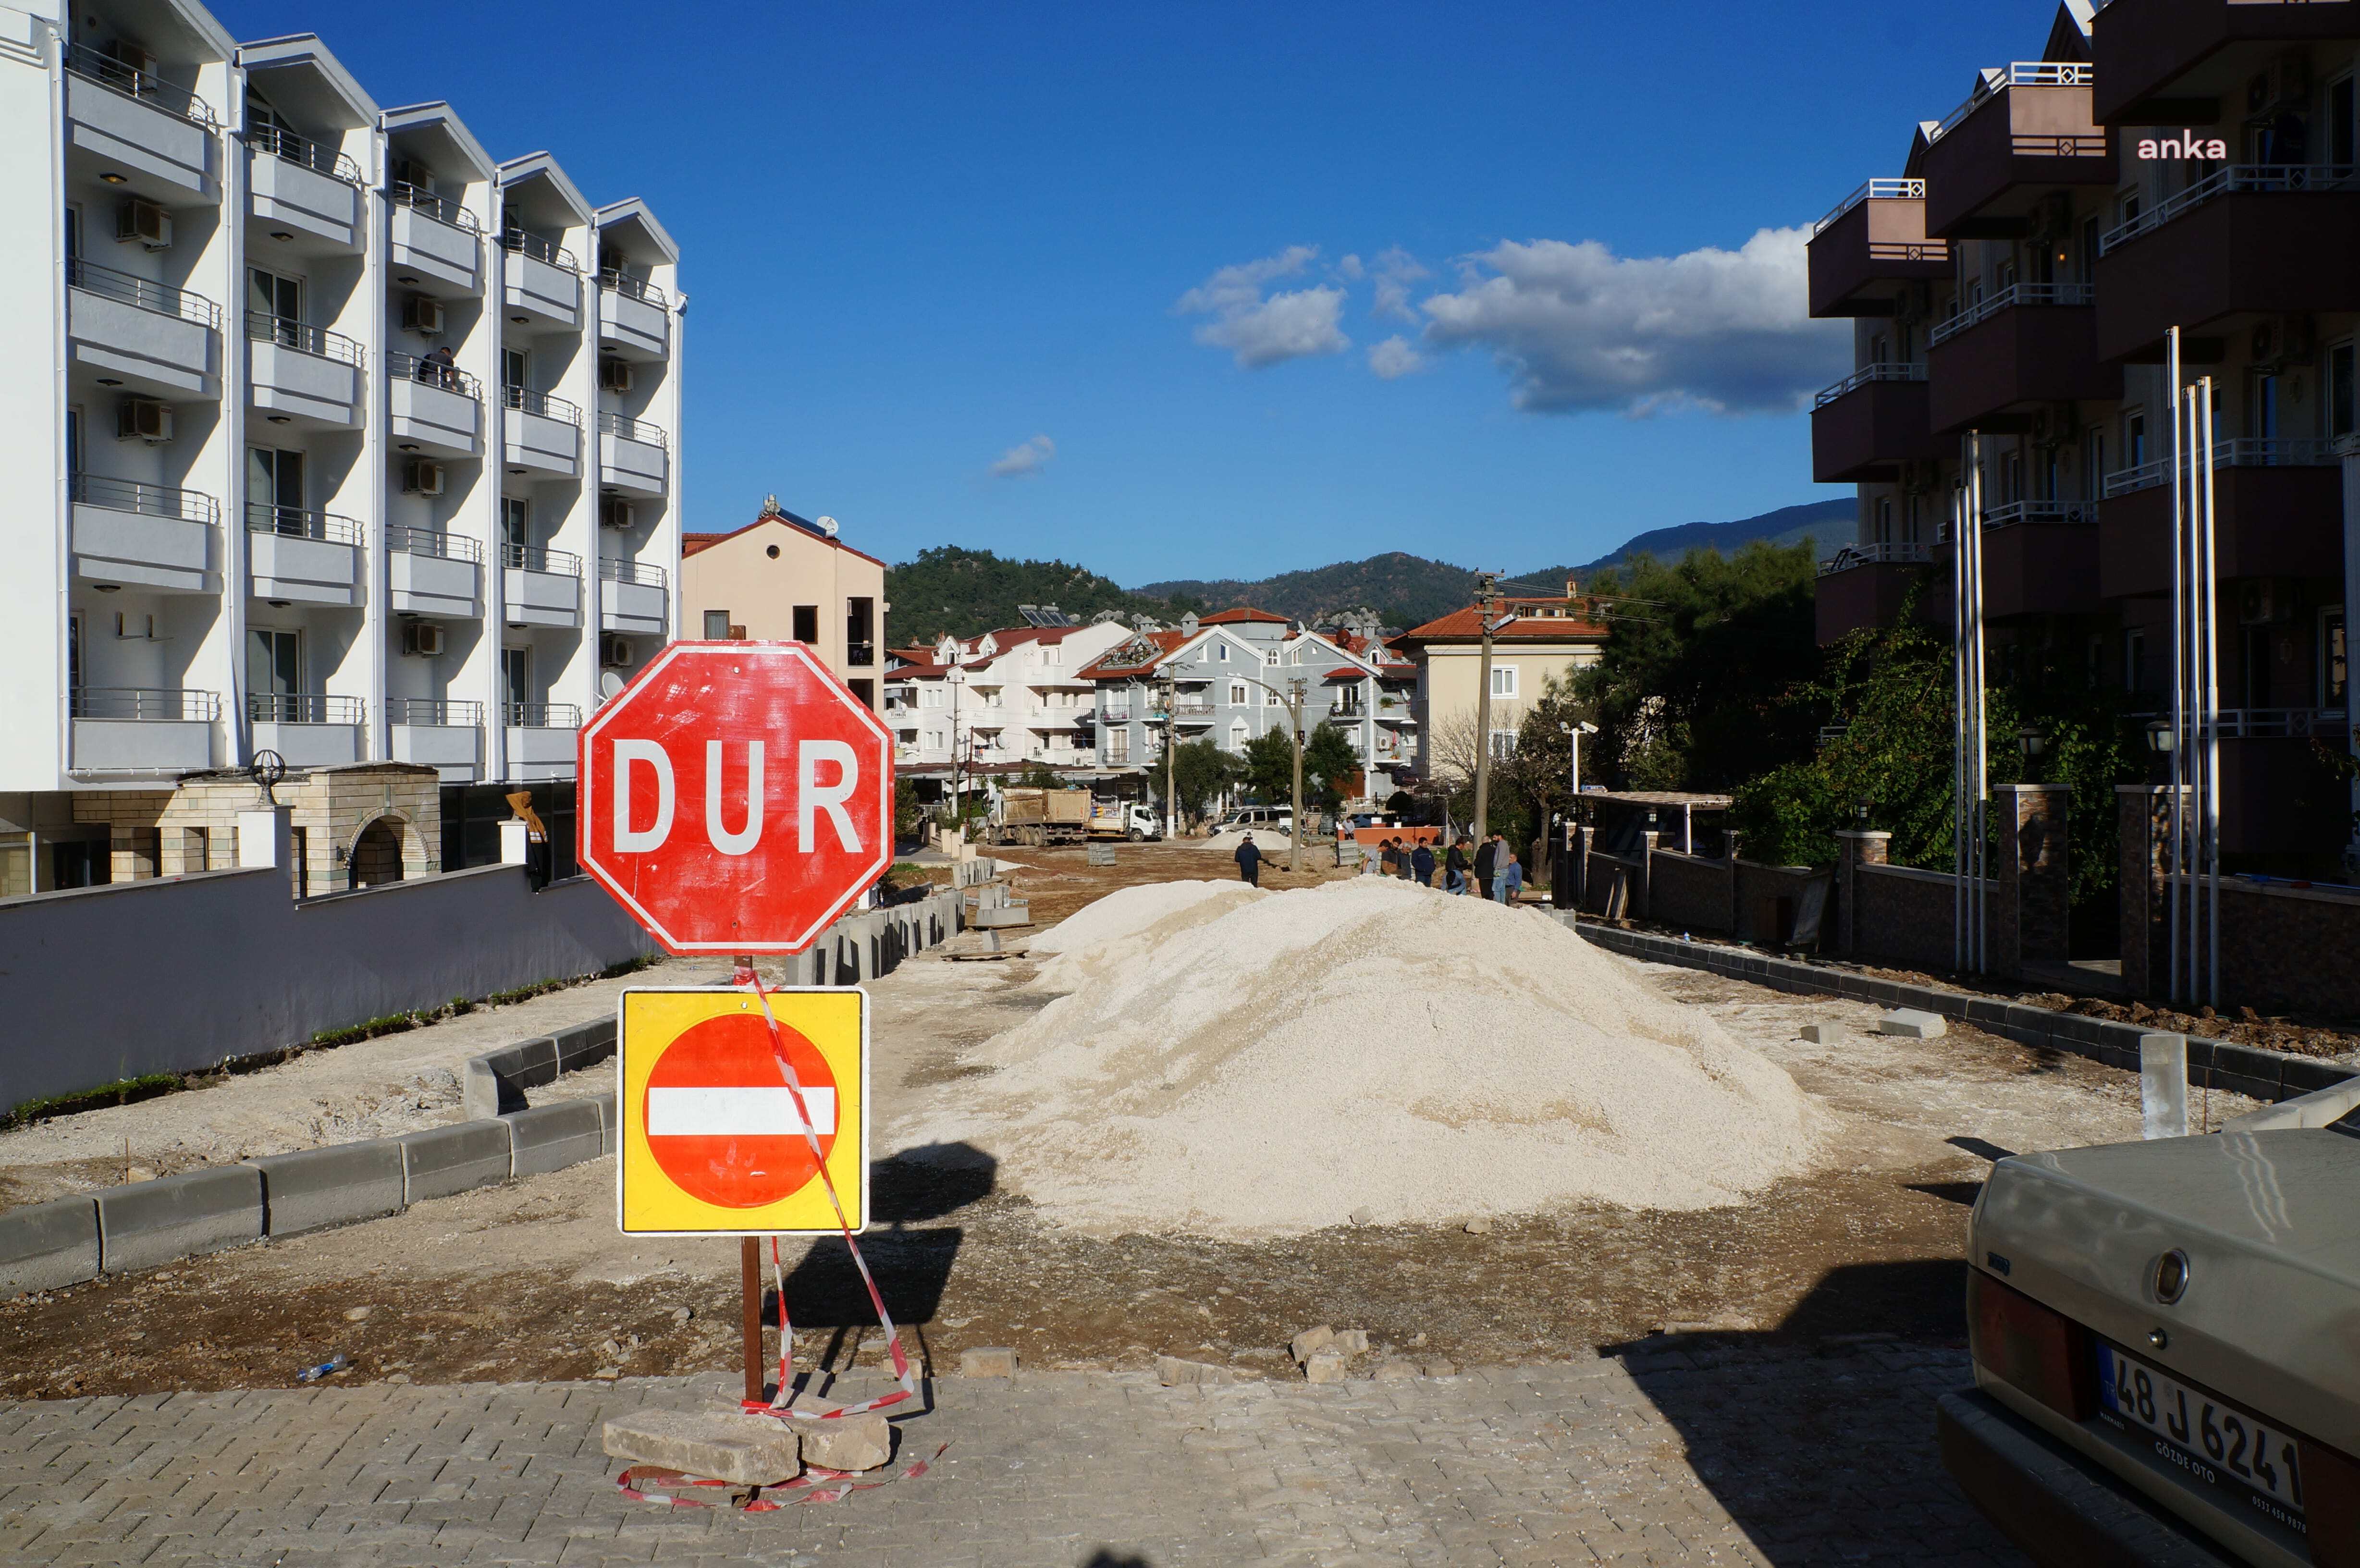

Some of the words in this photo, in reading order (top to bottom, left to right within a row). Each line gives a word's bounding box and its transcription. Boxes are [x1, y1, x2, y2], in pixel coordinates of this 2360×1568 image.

[613, 738, 863, 856] DUR
[2117, 1359, 2156, 1424] 48
[2167, 1390, 2190, 1444] J
[2200, 1402, 2303, 1506] 6241
[2155, 1441, 2190, 1470] GÖZDE
[2192, 1461, 2215, 1484] OTO
[2252, 1495, 2270, 1513] 0533
[2272, 1507, 2285, 1522] 458
[2287, 1515, 2307, 1533] 9878
